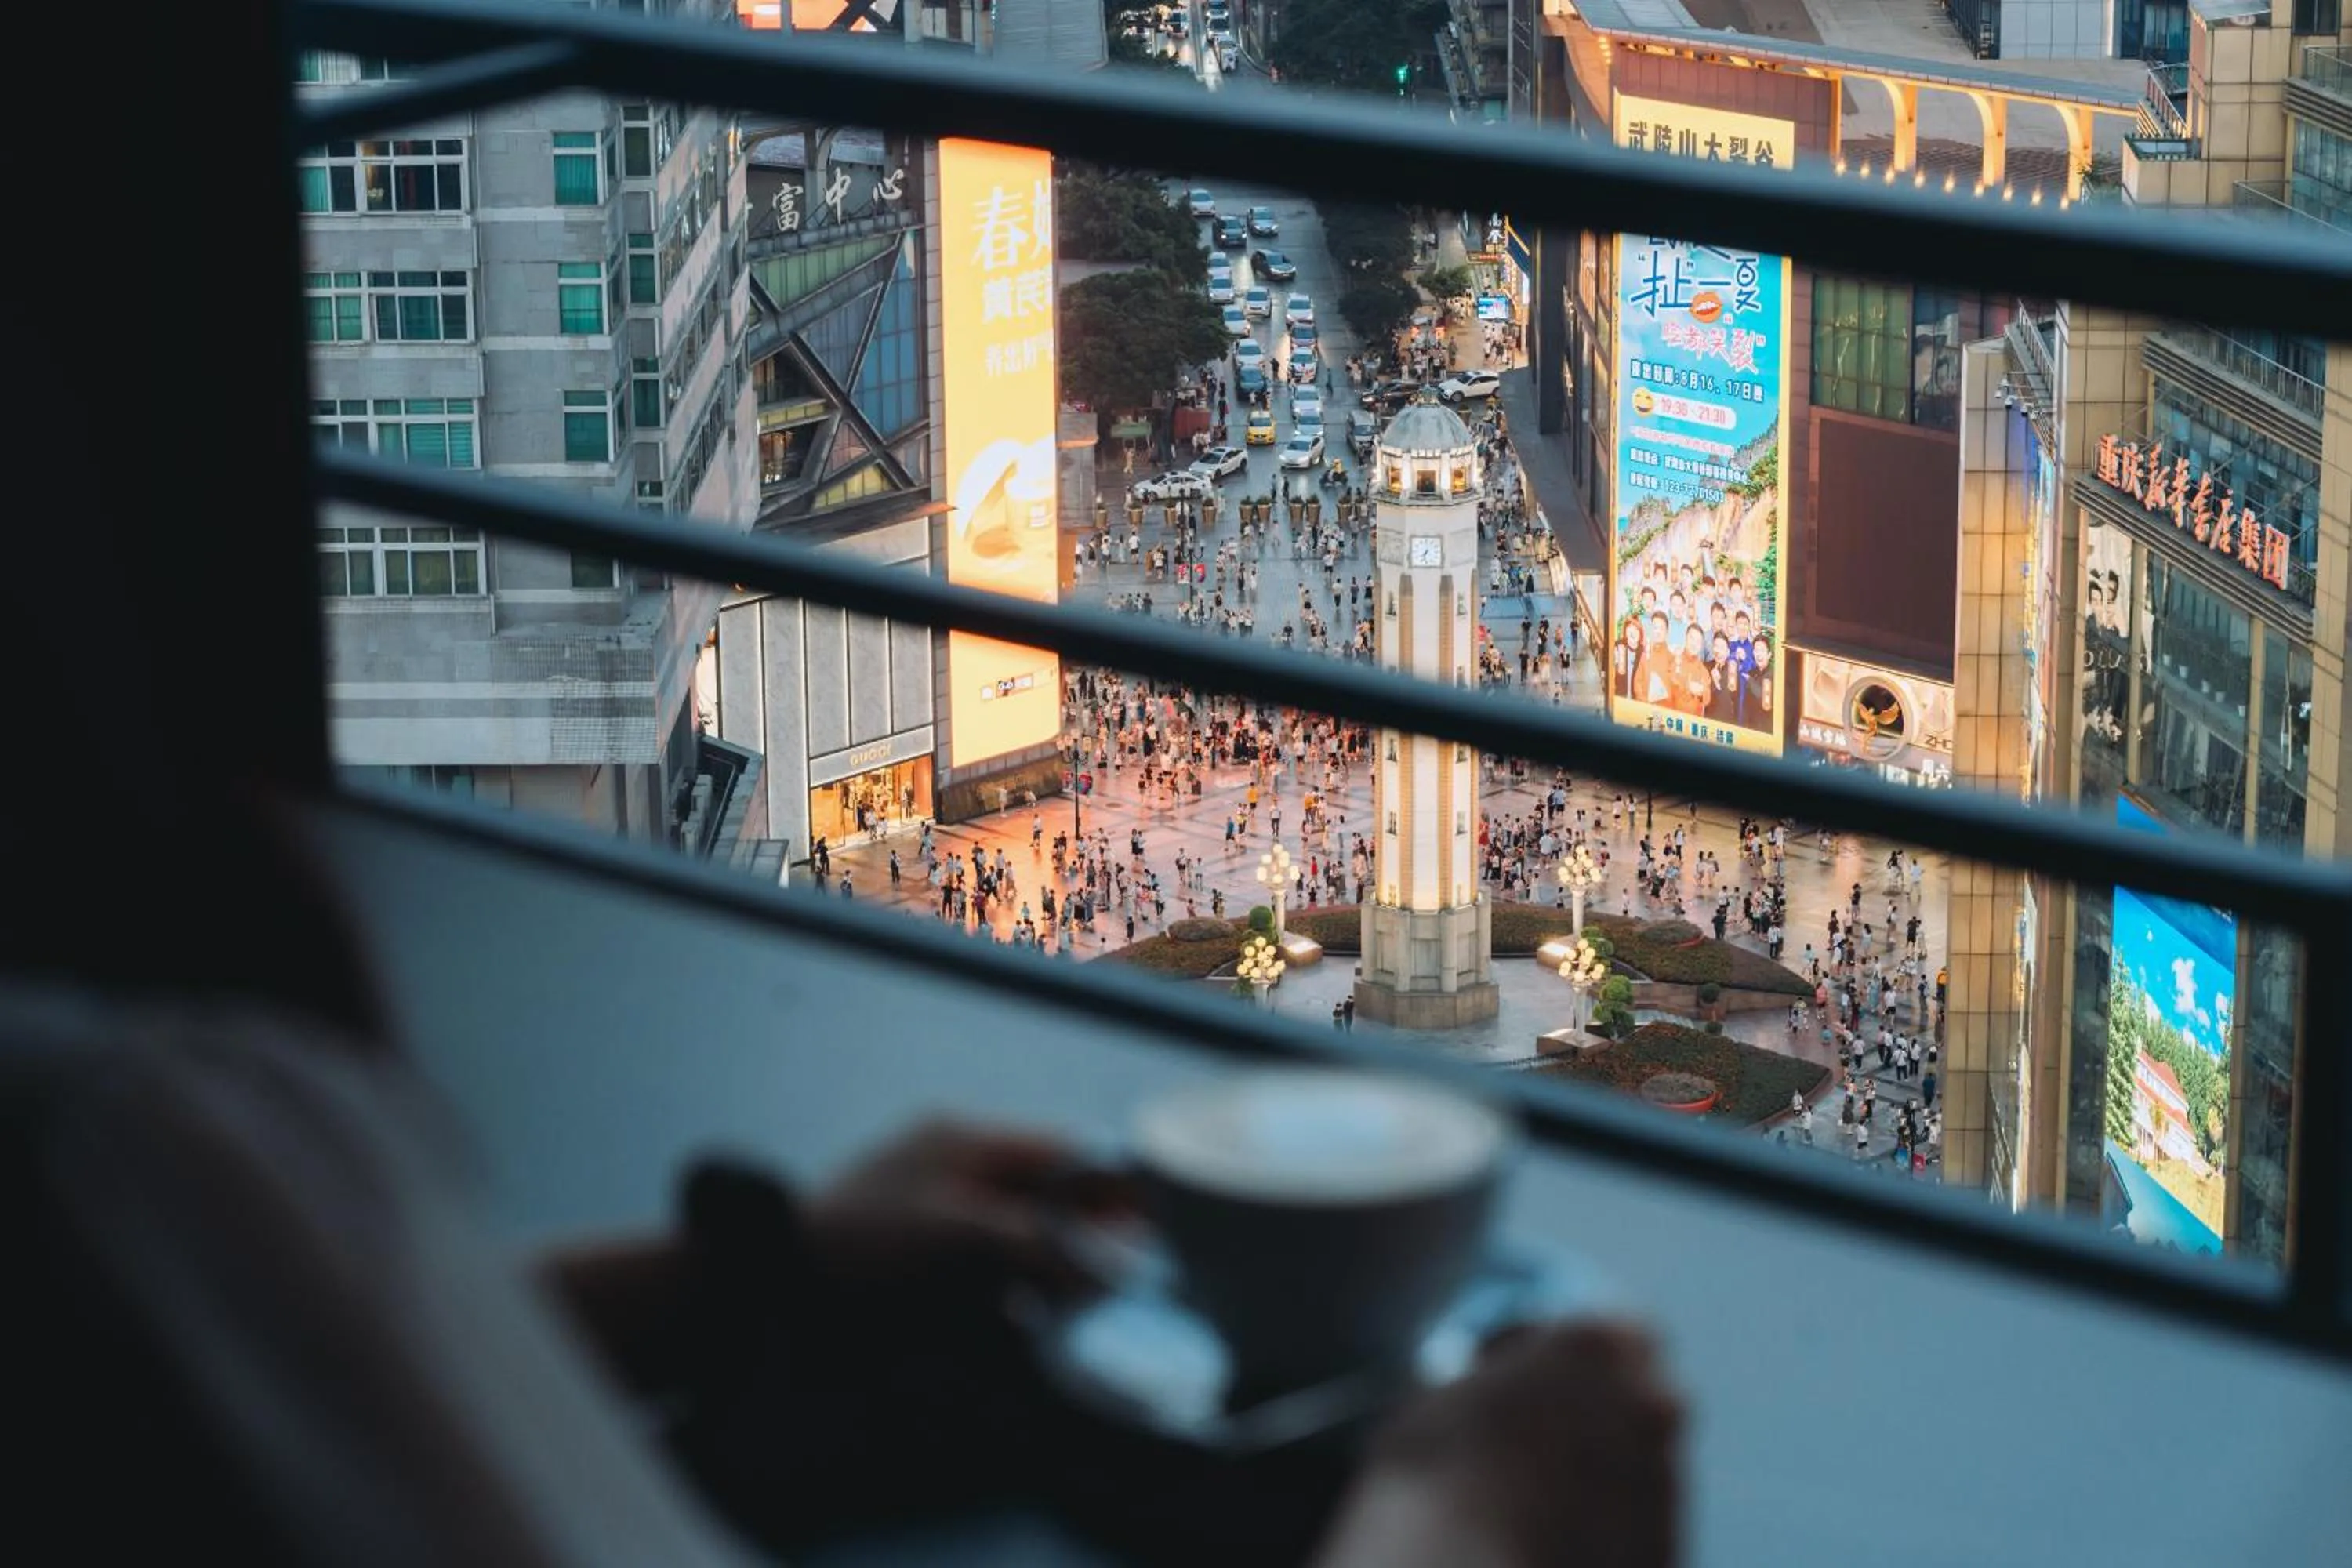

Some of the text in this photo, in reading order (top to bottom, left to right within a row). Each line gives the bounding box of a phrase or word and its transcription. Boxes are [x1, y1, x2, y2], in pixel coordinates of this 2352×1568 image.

[745, 167, 904, 232] 富中心
[851, 743, 891, 767] GUCCI
